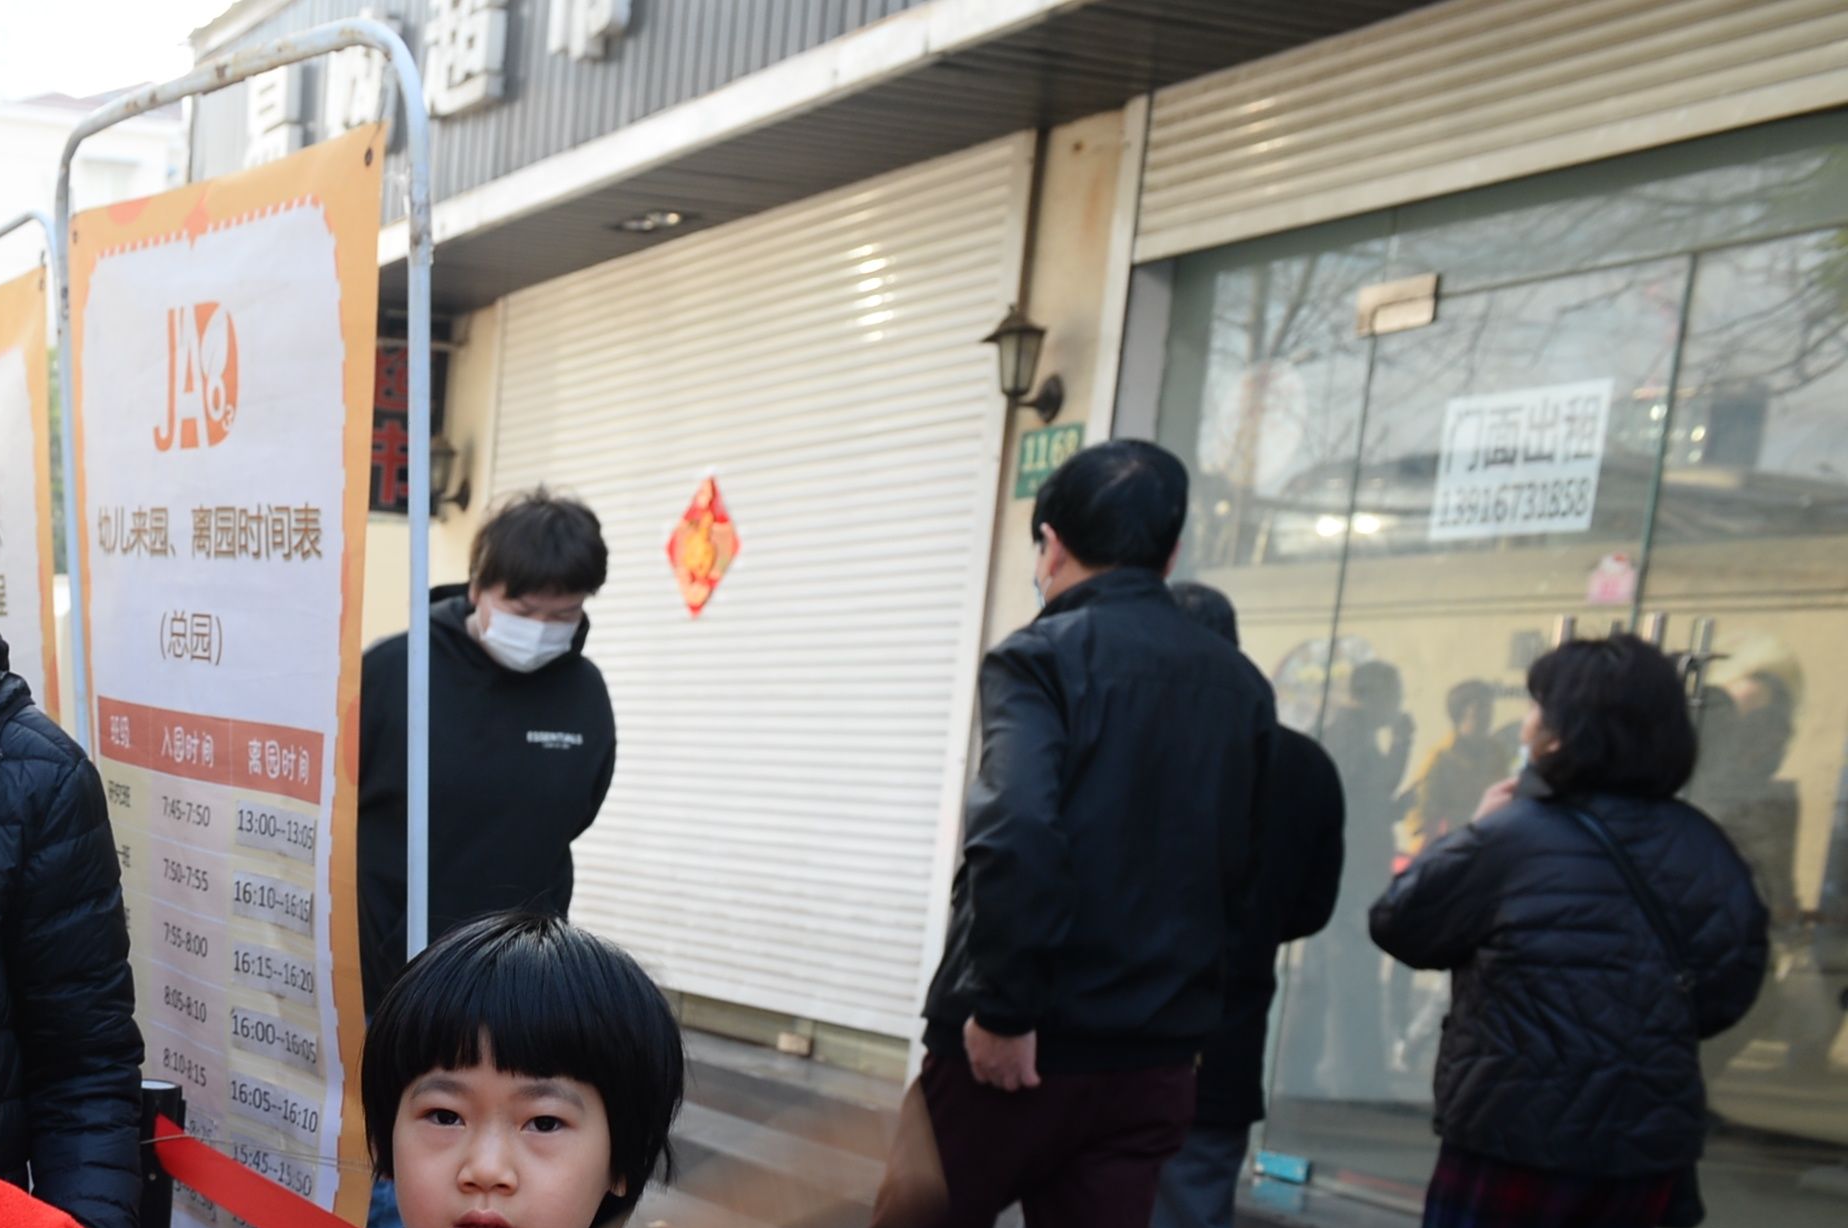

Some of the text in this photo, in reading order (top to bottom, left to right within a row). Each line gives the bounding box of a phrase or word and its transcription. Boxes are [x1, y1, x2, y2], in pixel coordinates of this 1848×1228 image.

[1447, 394, 1600, 472] 门面出租
[98, 502, 322, 561] 幼儿来园、离园时间表
[160, 609, 222, 667] (总园)
[161, 725, 214, 768] 入园时间
[248, 737, 310, 786] 离园时间
[162, 795, 211, 828] 7:45-7:50
[163, 857, 209, 892] 7:50-7:55
[163, 921, 208, 958] 7:55-8:00
[164, 985, 208, 1024] 8:05-8:10
[163, 1047, 207, 1088] 8:10-8:15
